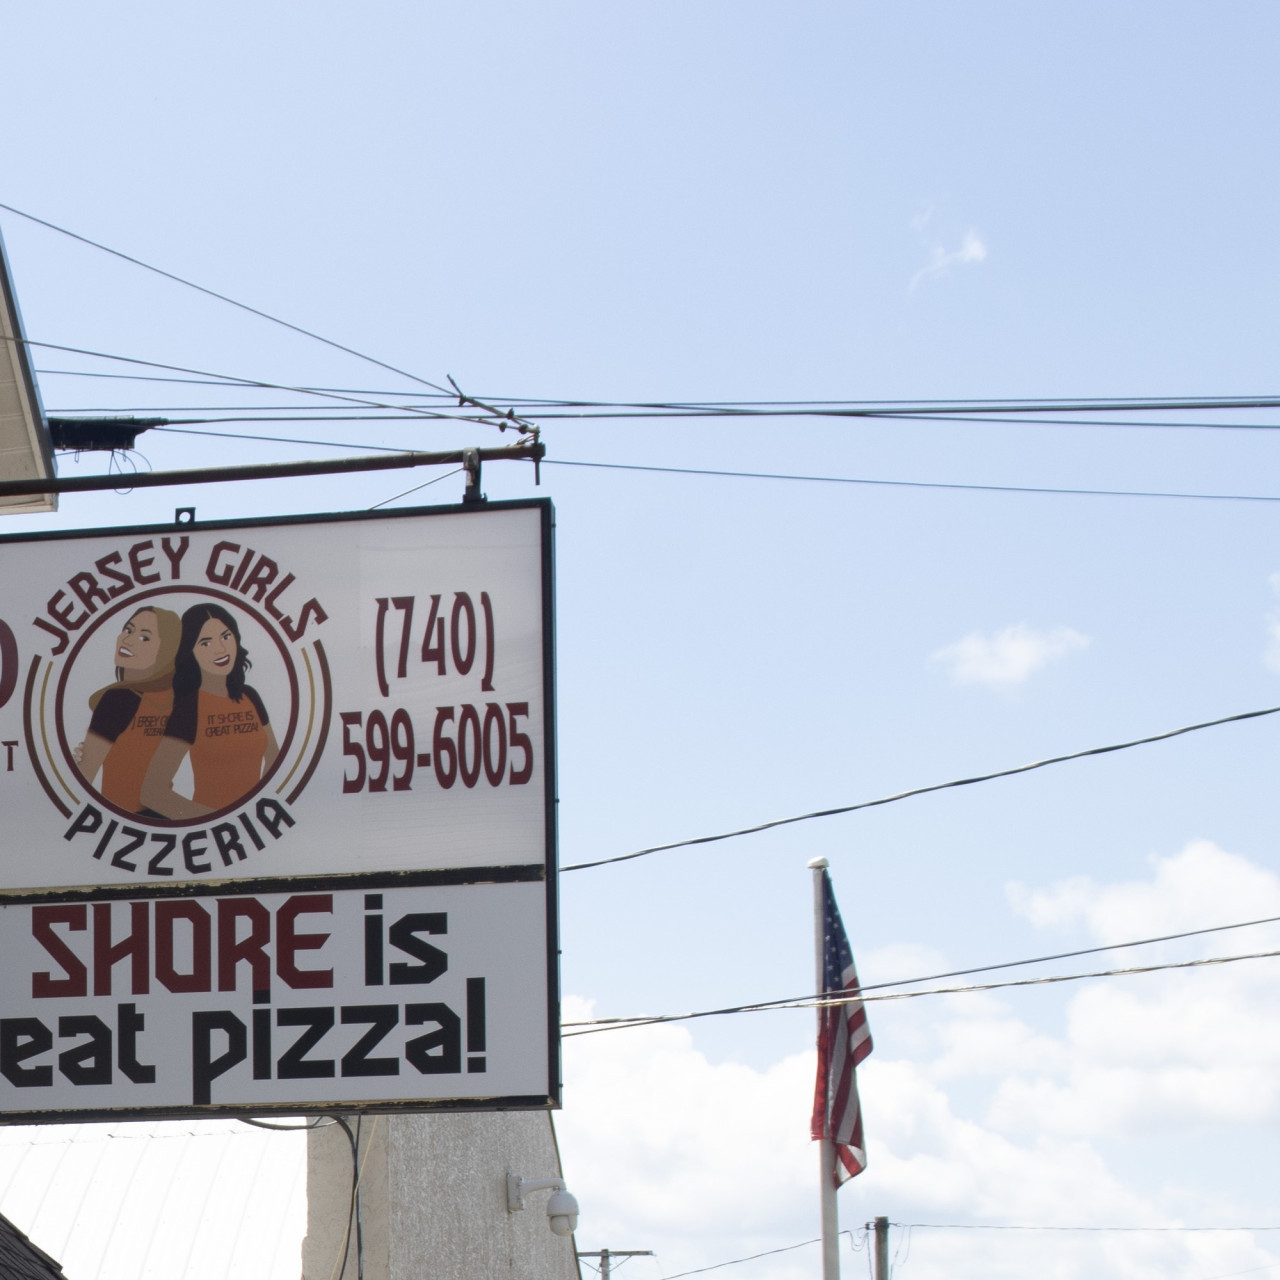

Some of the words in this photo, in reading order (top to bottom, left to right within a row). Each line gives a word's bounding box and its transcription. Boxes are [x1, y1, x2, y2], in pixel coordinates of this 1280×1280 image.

[32, 536, 190, 656] JERSEY
[205, 540, 329, 643] GIRLS
[376, 592, 495, 697] (740)
[340, 702, 533, 793] 599-6005
[63, 797, 296, 876] PIZZERIA
[32, 894, 334, 998] SHORE
[364, 894, 448, 986] is
[192, 976, 487, 1105] pizza!
